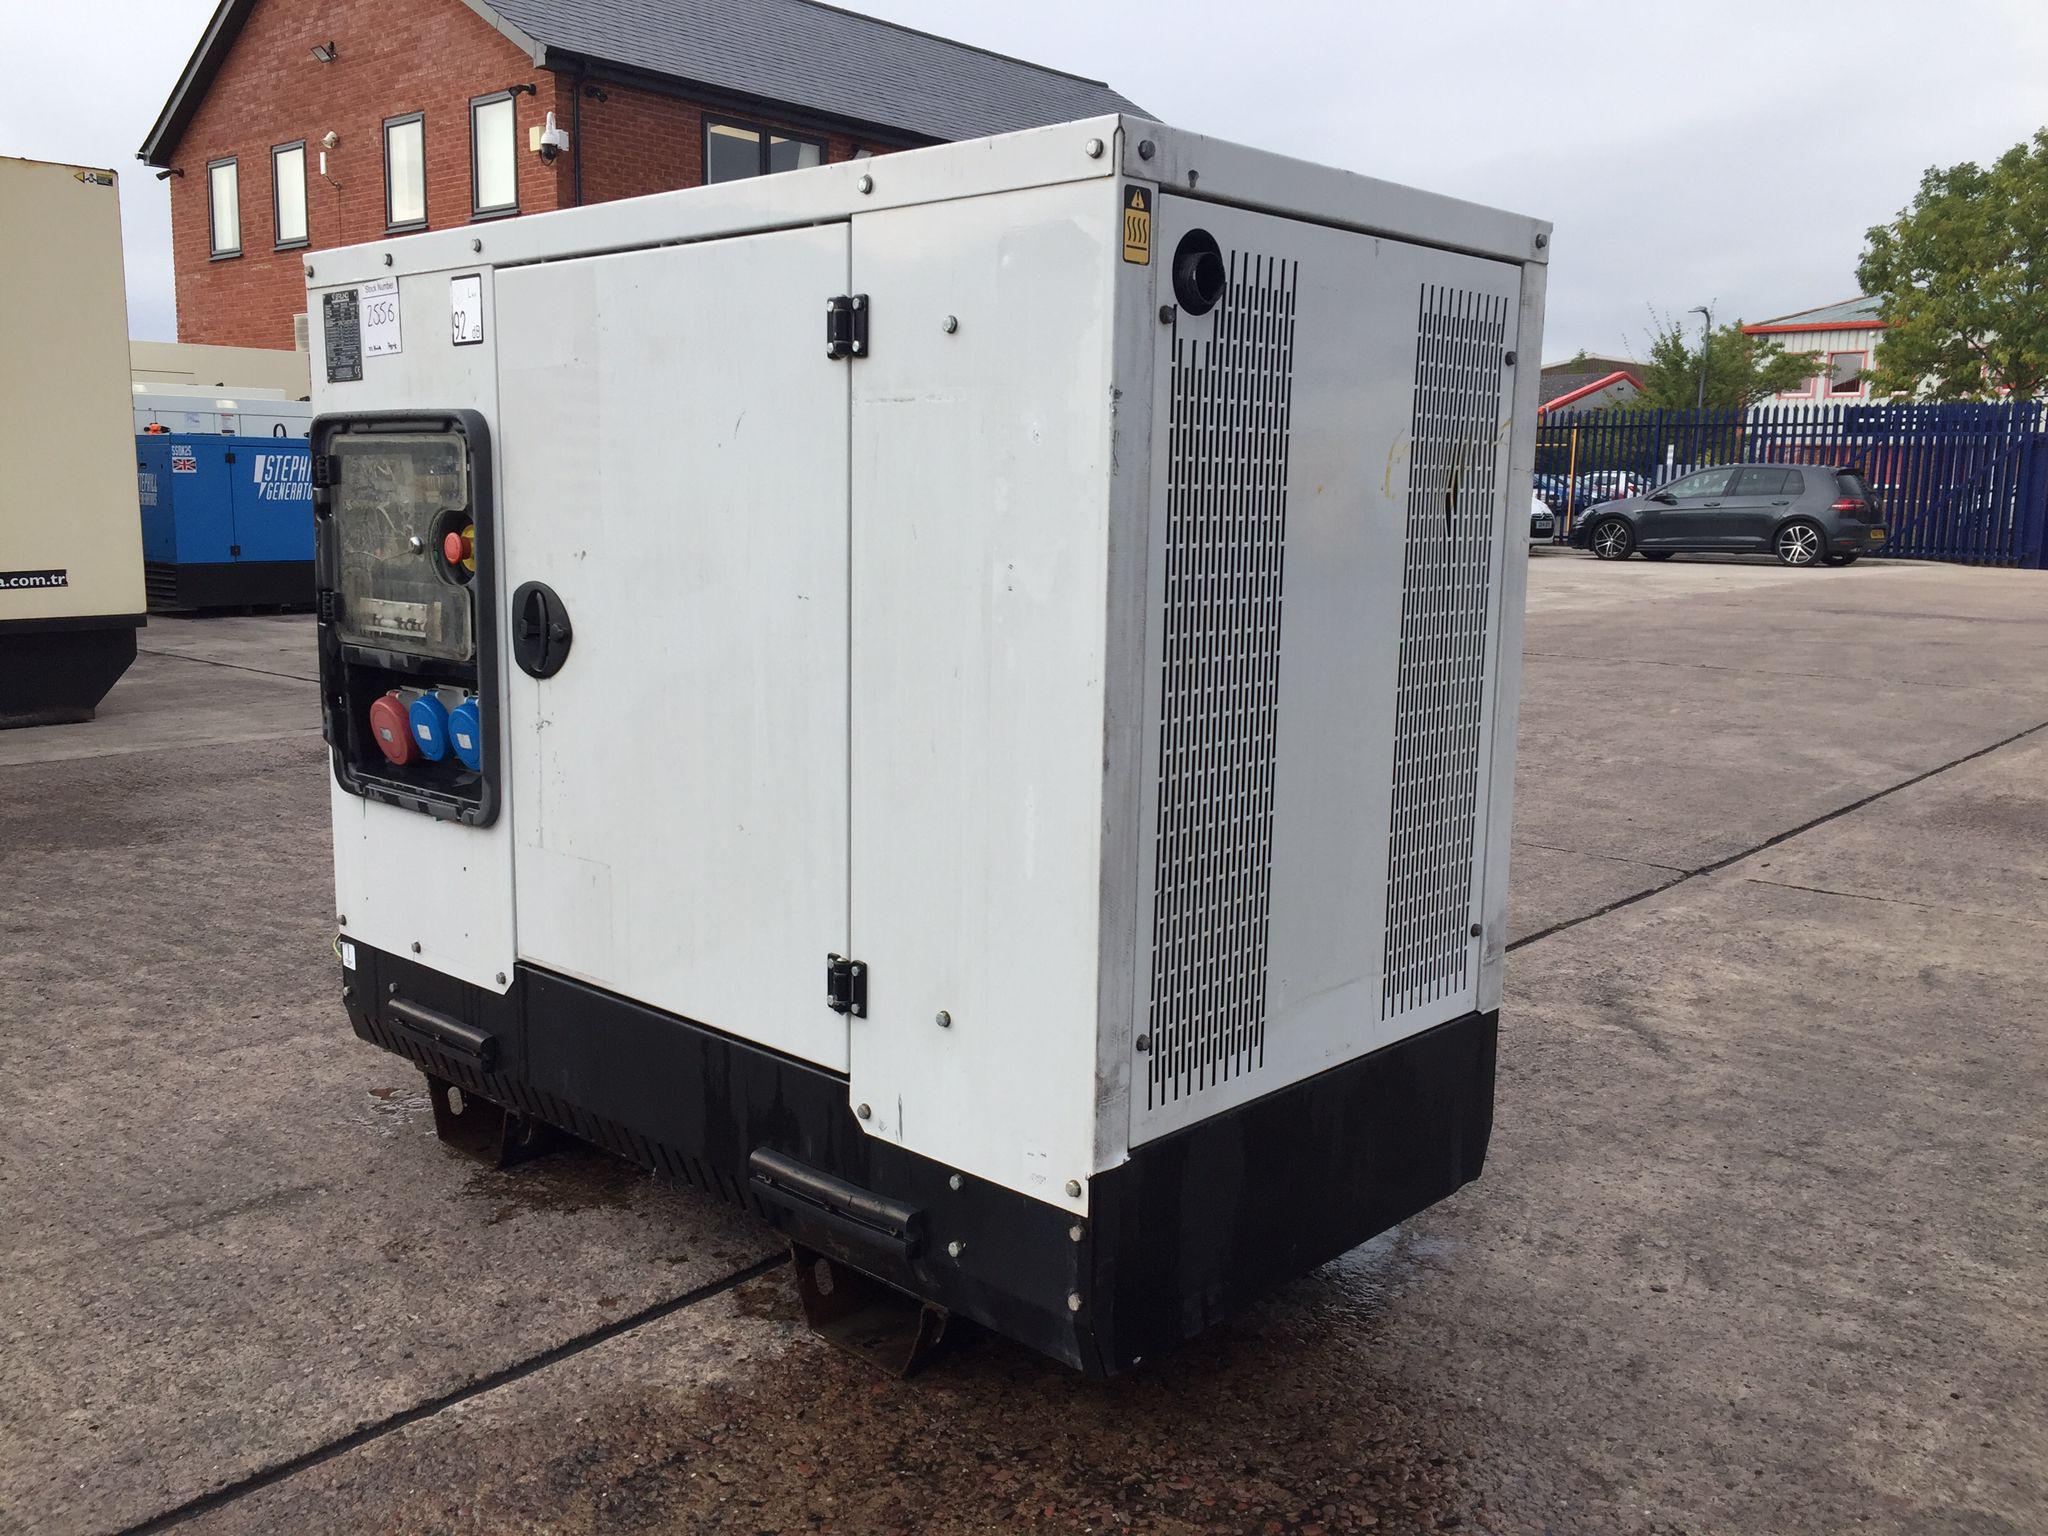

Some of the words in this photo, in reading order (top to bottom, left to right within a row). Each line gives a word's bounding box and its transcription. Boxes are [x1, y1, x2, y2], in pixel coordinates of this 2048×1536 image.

[364, 284, 377, 294] Stock
[377, 281, 394, 291] Number
[367, 301, 395, 327] 2556
[453, 310, 467, 340] 92
